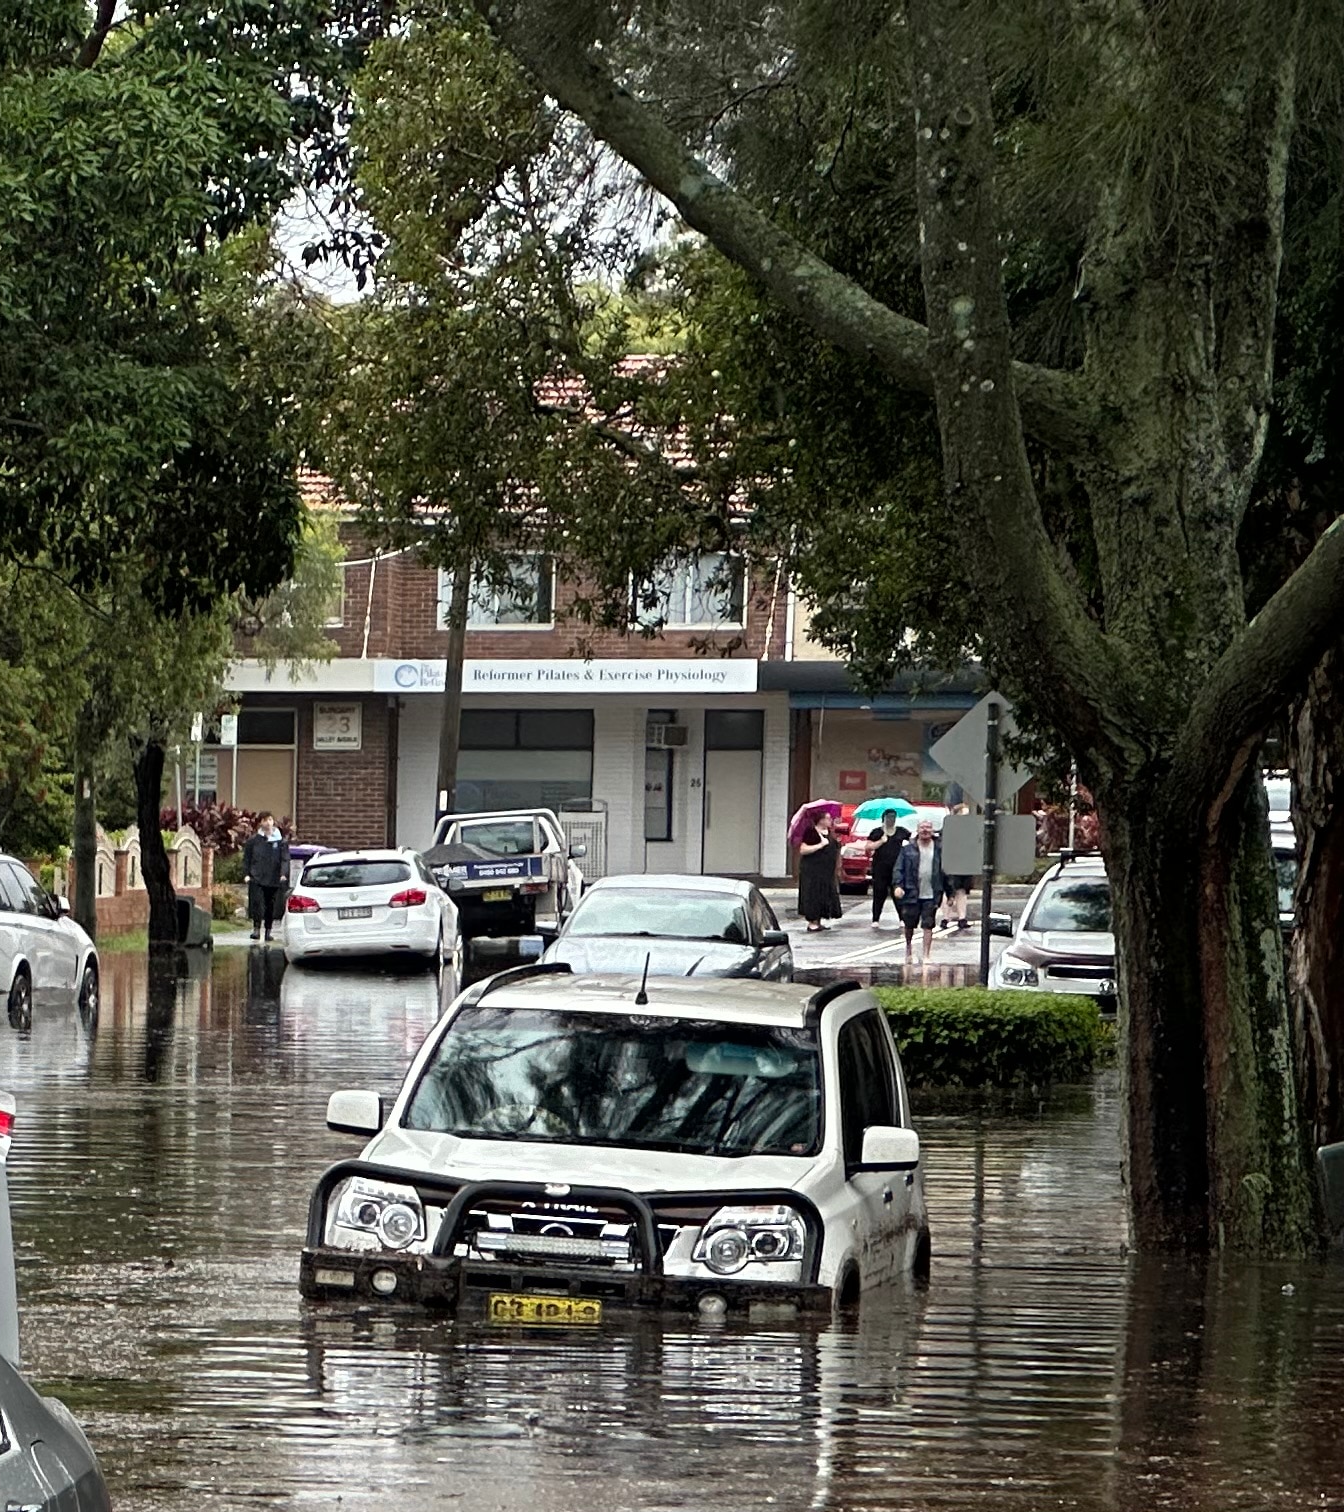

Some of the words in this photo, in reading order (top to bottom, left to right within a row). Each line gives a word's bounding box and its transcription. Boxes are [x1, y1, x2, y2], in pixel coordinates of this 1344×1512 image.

[473, 668, 533, 681] Reformer
[537, 668, 580, 681] Pilates
[583, 669, 594, 681] &
[599, 669, 652, 681] Exercise
[657, 668, 727, 684] Physiology
